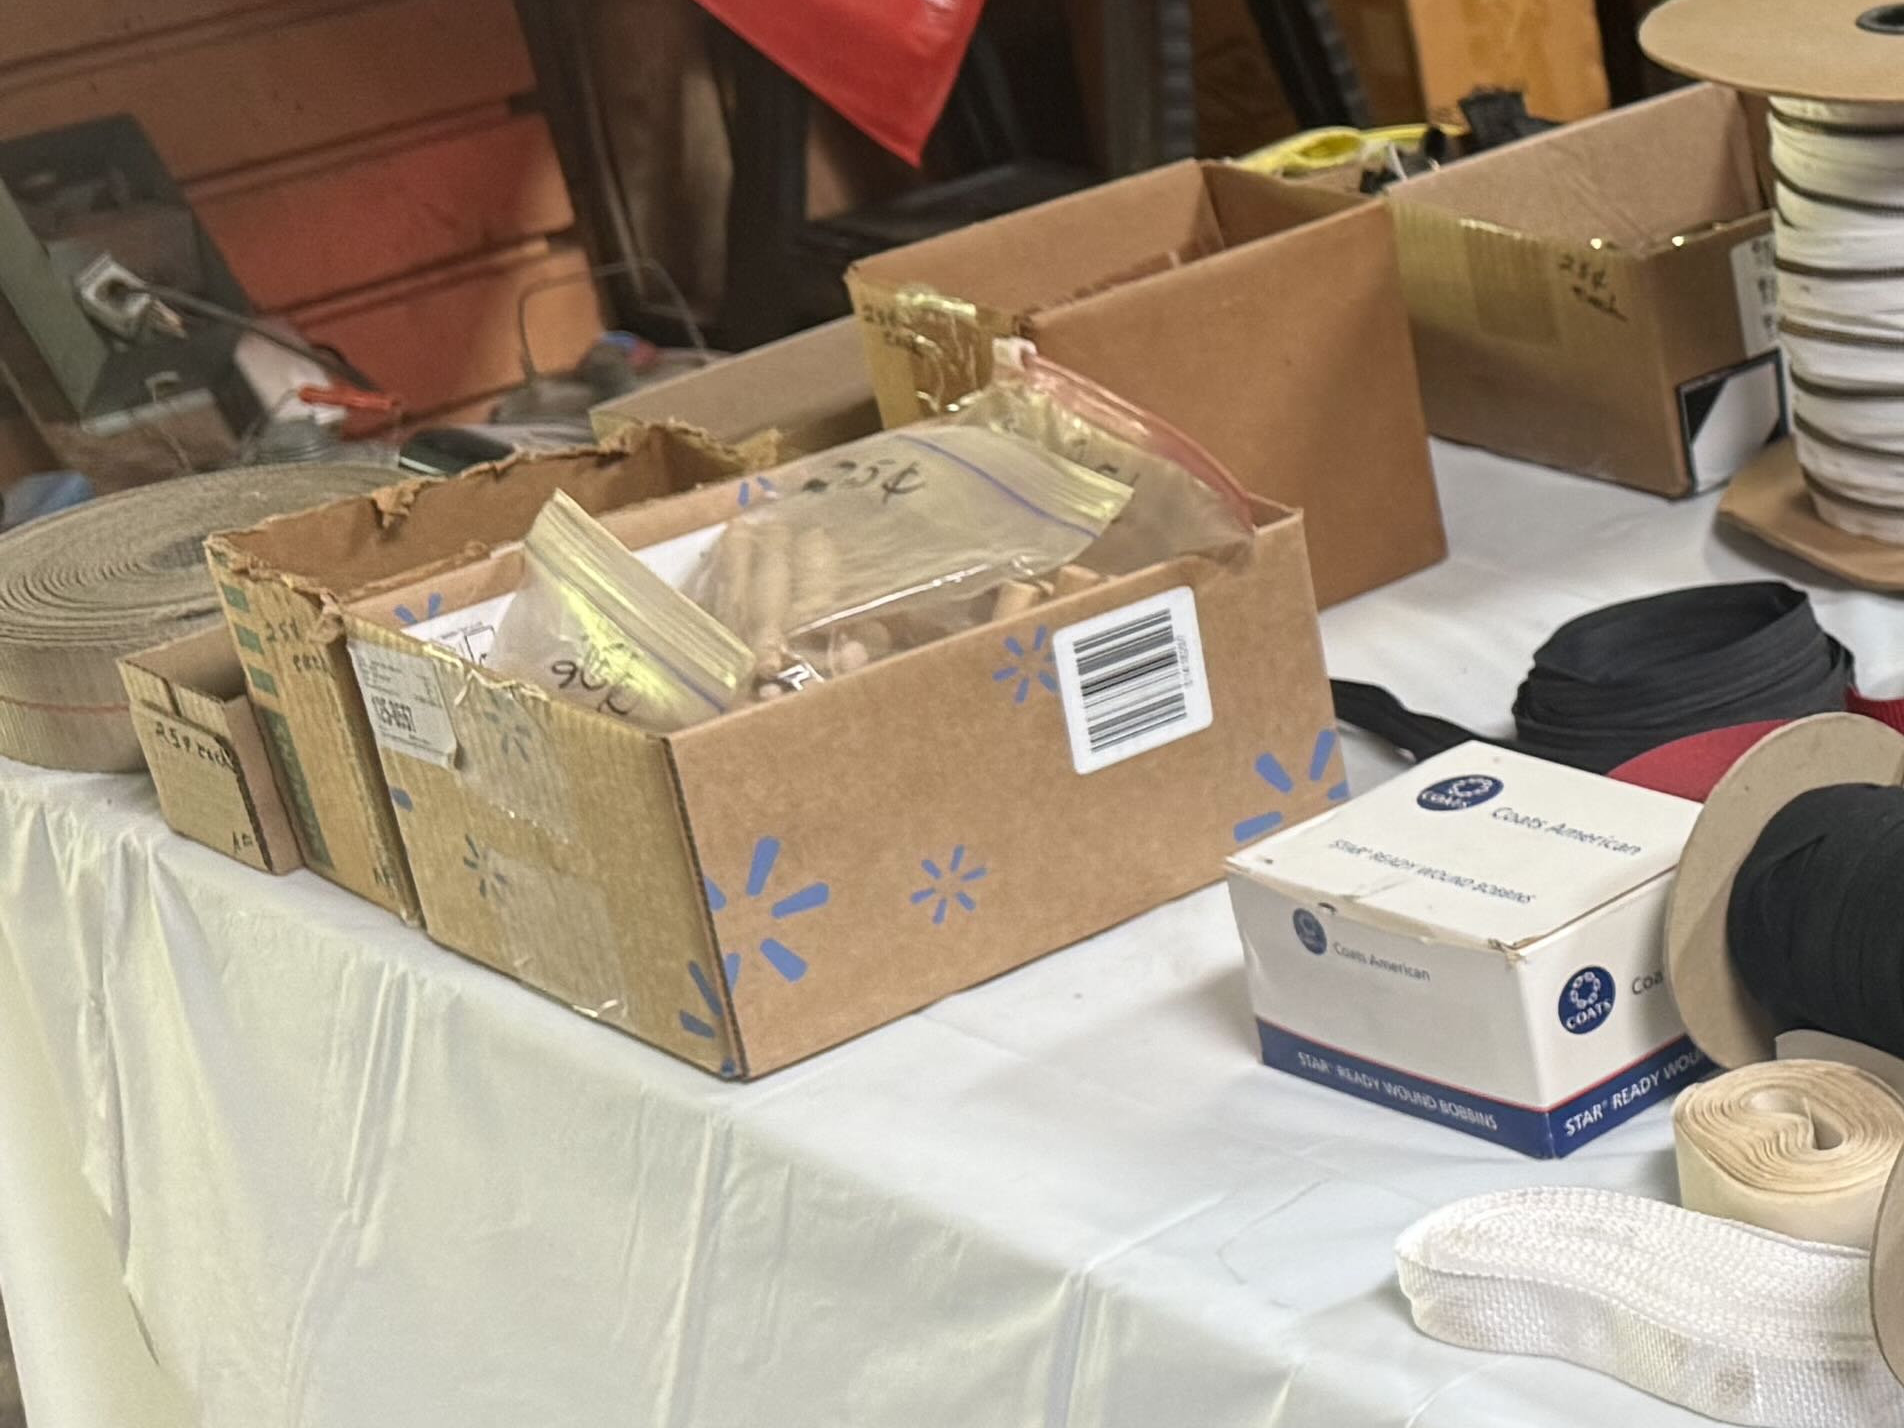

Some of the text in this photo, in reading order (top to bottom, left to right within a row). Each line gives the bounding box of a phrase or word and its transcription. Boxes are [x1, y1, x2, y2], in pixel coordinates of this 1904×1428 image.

[1547, 822, 1643, 857] American
[1332, 941, 1432, 983] Coats American
[1631, 971, 1665, 996] Coa
[1565, 998, 1612, 1030] COATS
[1336, 1063, 1382, 1092] READY
[1382, 1080, 1438, 1110] WOUND
[1438, 1097, 1499, 1131] BOBBINS
[1611, 1070, 1661, 1111] READY
[1663, 1050, 1702, 1080] WOU
